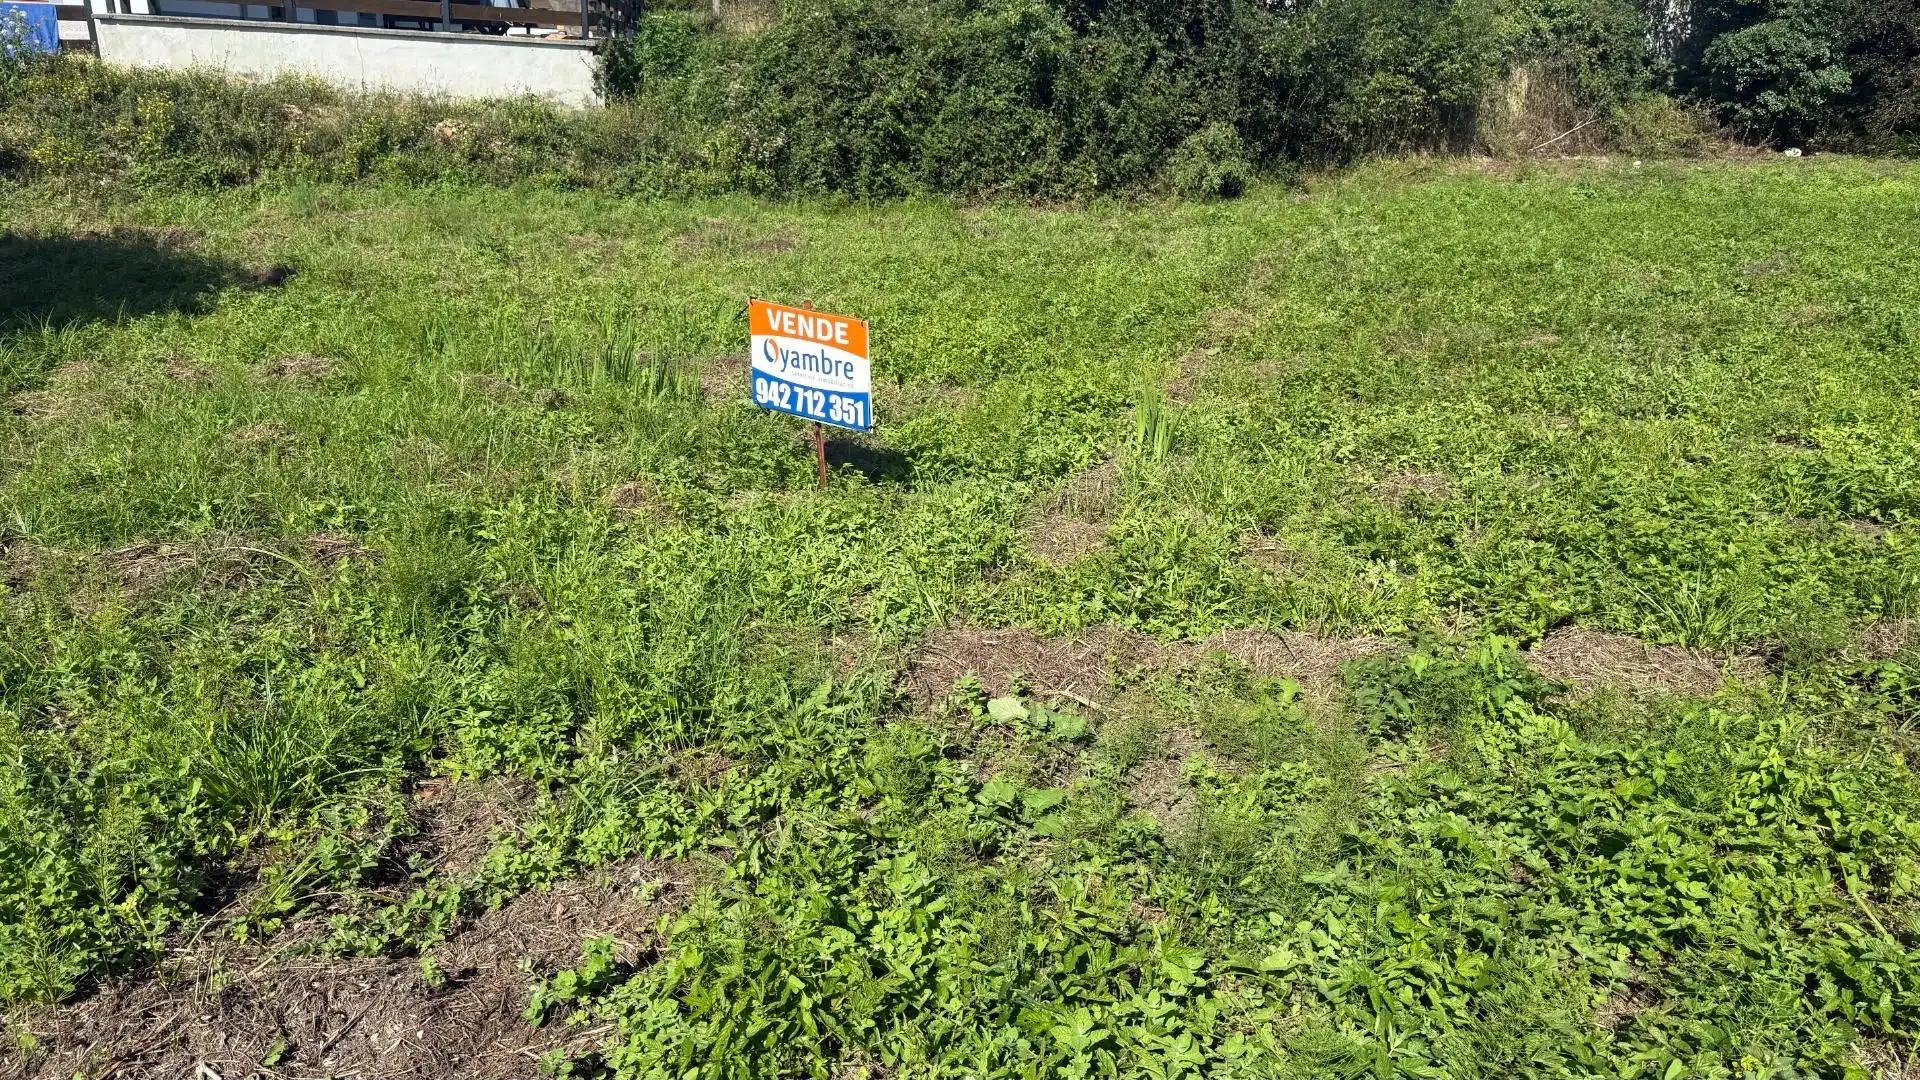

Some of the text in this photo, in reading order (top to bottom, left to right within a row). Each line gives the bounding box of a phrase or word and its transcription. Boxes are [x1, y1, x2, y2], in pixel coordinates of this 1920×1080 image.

[766, 308, 849, 345] VENDE
[763, 338, 854, 380] Oyambre
[755, 377, 792, 410] 942
[794, 386, 826, 418] 712
[829, 394, 864, 427] 351
